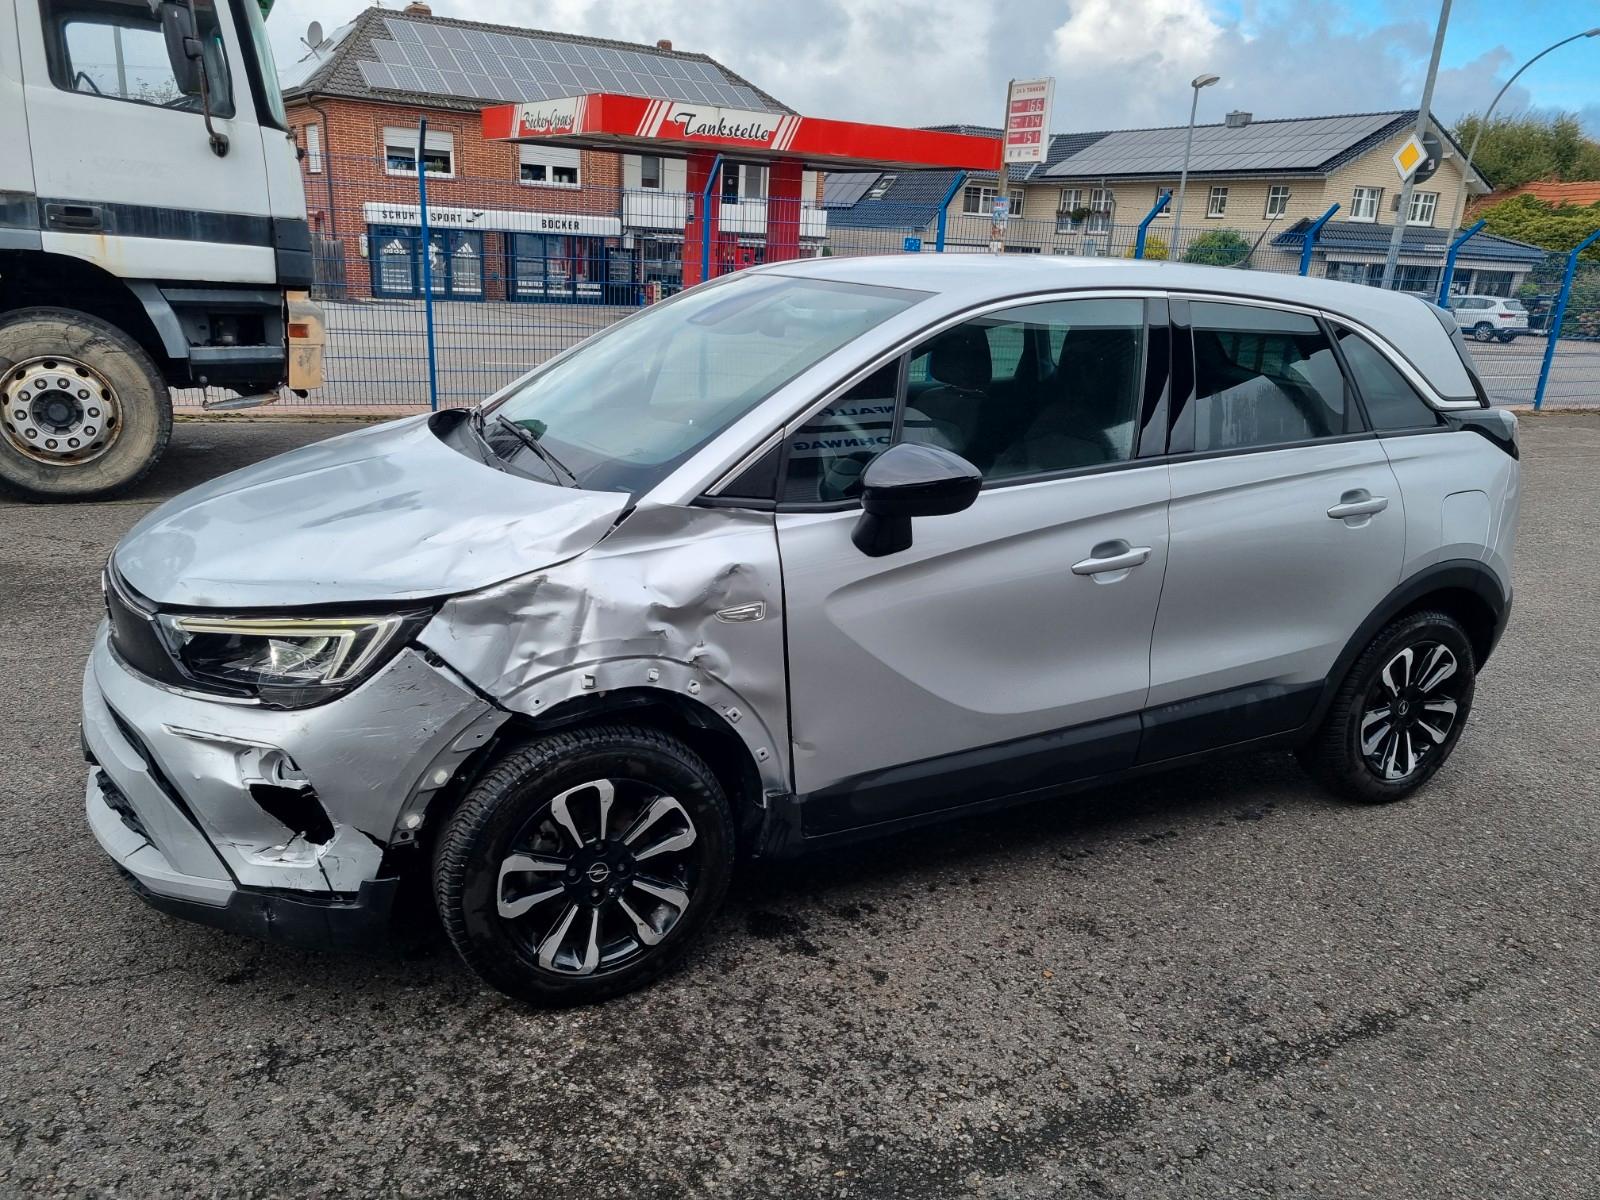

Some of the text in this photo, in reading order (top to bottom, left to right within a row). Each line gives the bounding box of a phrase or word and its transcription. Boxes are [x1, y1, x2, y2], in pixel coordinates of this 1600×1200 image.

[674, 112, 769, 141] Tankstelle
[382, 210, 461, 223] SCHUH SPORT
[541, 218, 580, 230] BÖCKER
